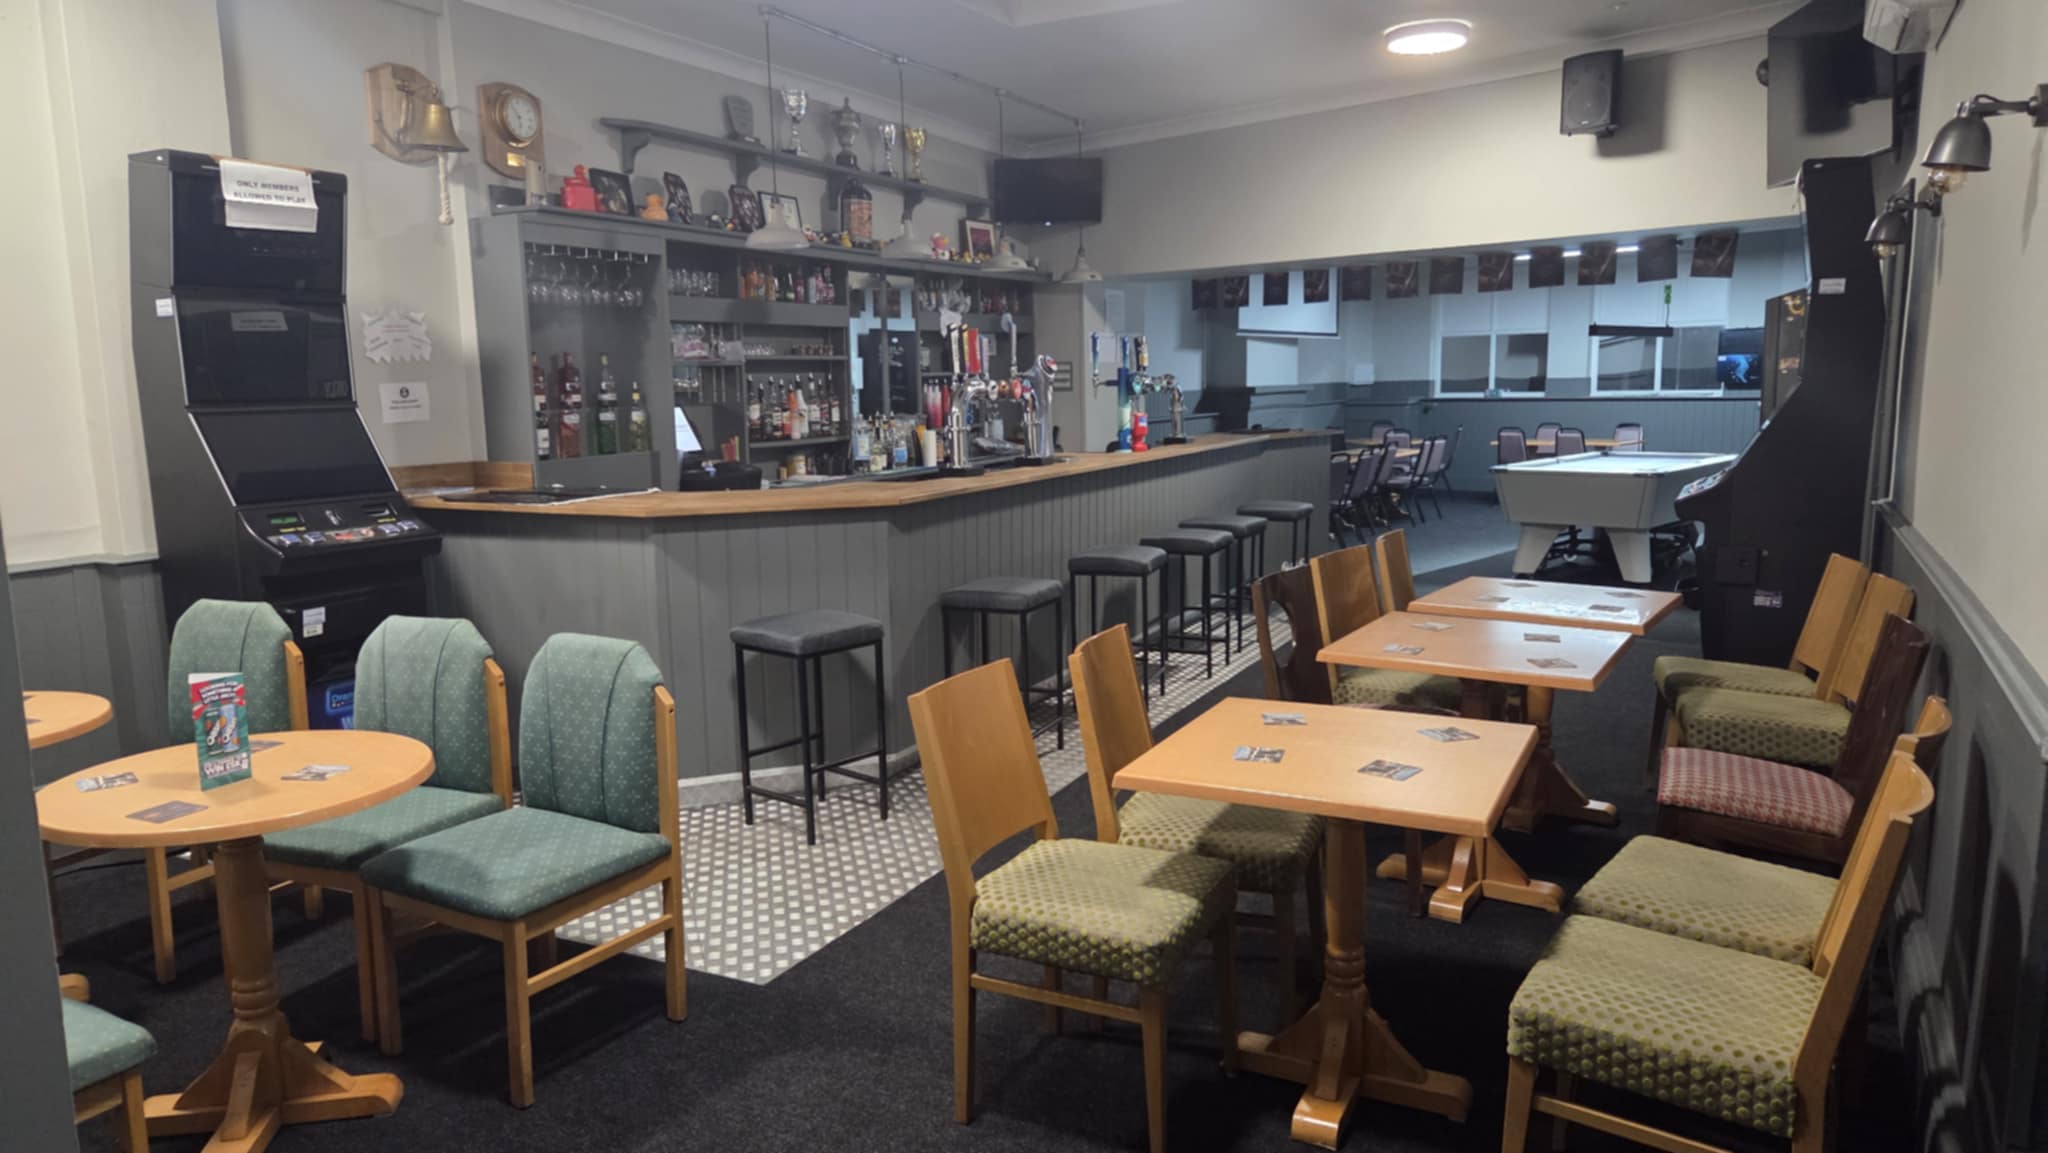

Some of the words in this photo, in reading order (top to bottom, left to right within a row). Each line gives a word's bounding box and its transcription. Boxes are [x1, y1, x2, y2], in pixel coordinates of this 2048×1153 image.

[236, 180, 258, 188] ONLY
[260, 183, 300, 192] MEMBERS
[233, 191, 272, 201] ALLOWED
[273, 194, 285, 202] TO
[286, 195, 306, 203] PLAY
